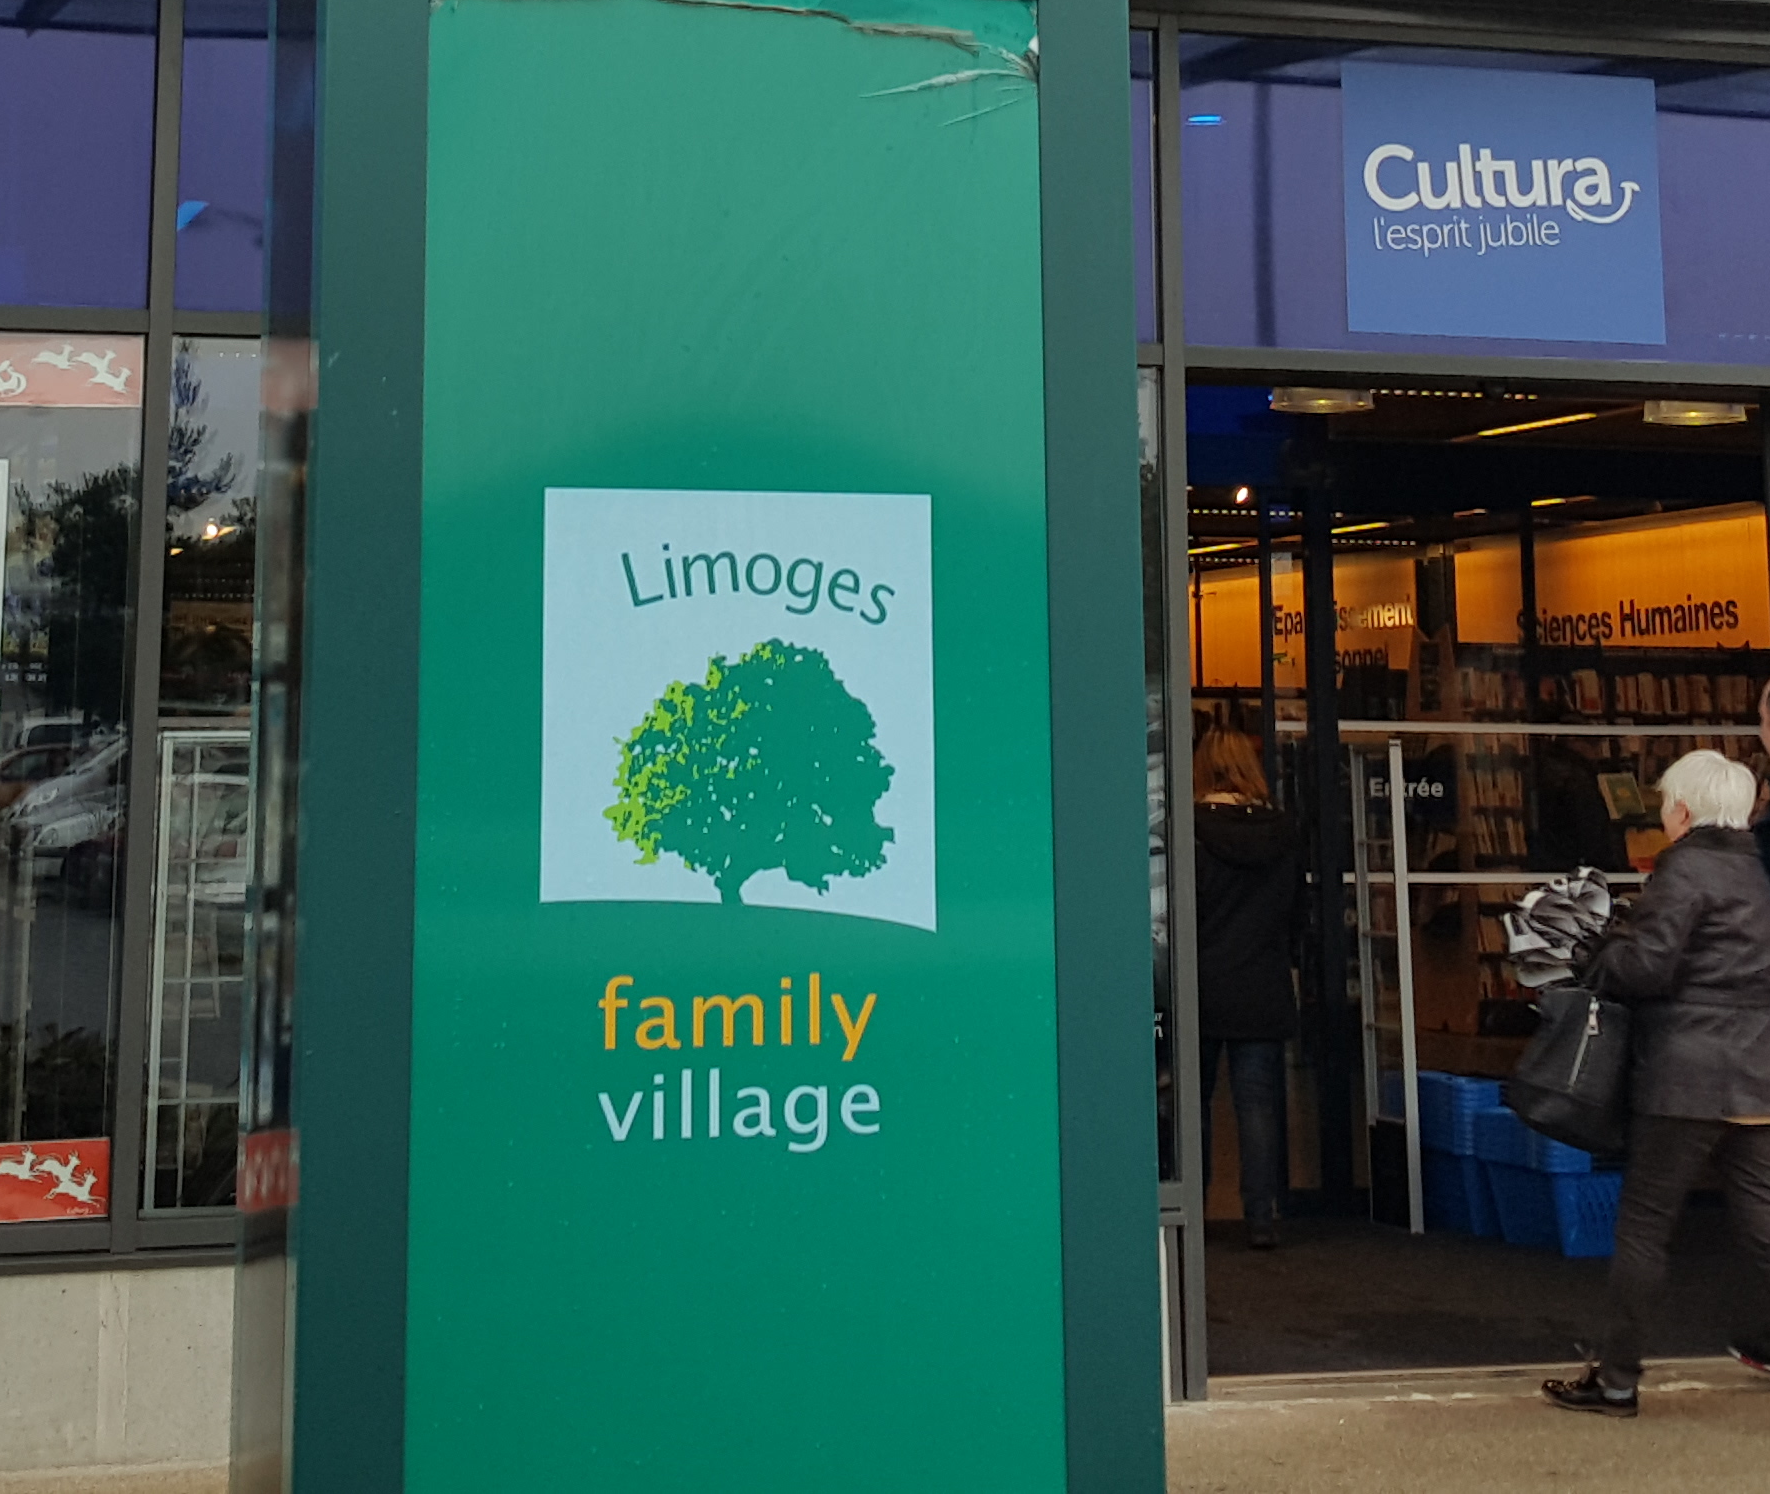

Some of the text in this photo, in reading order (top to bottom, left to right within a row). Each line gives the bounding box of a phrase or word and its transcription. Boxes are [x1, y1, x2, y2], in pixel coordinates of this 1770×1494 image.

[1364, 143, 1631, 214] Cultura
[1373, 214, 1561, 258] l'esprit jubile
[621, 543, 895, 625] Limoges
[1619, 594, 1740, 638] Humaines
[1370, 777, 1444, 797] Erée
[597, 973, 877, 1062] family
[597, 1067, 881, 1154] village
